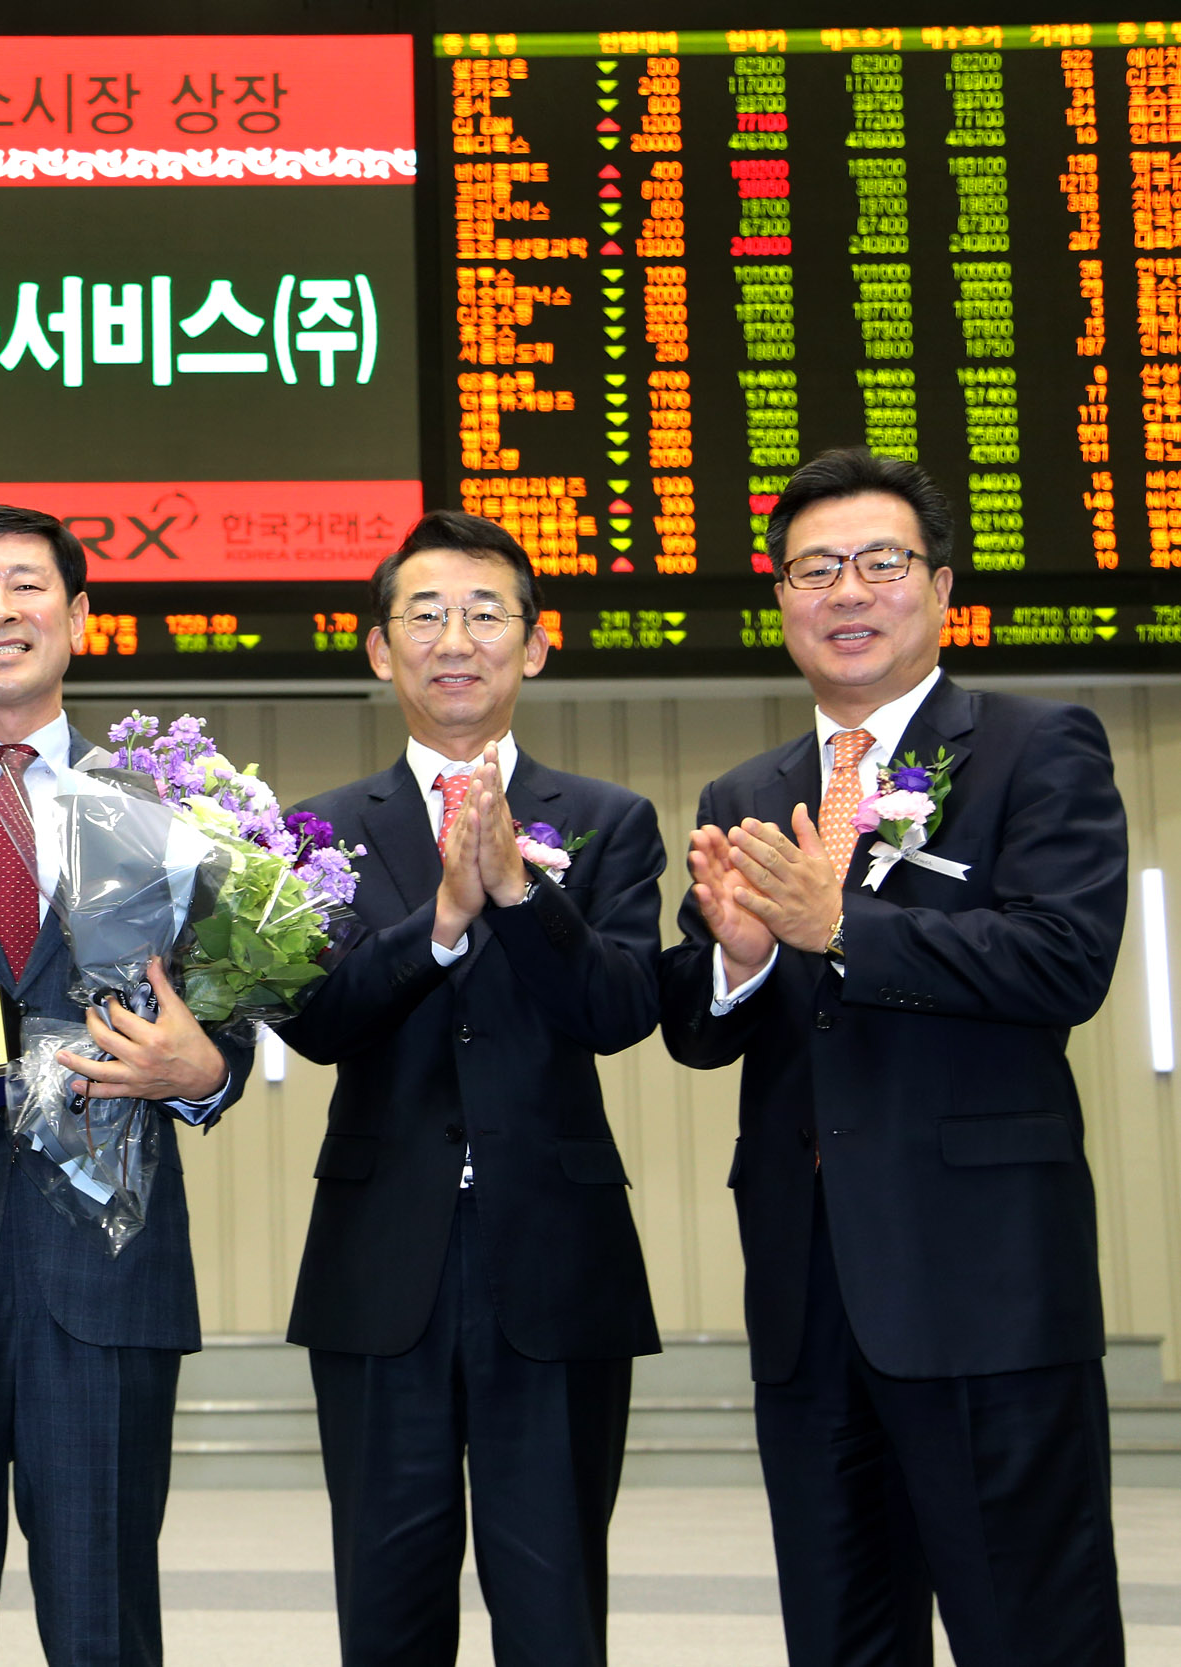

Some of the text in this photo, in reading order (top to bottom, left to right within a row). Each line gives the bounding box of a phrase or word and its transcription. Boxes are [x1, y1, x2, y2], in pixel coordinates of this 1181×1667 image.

[171, 73, 288, 134] 상장
[63, 516, 180, 560] RX
[221, 511, 396, 545] 한국거래소
